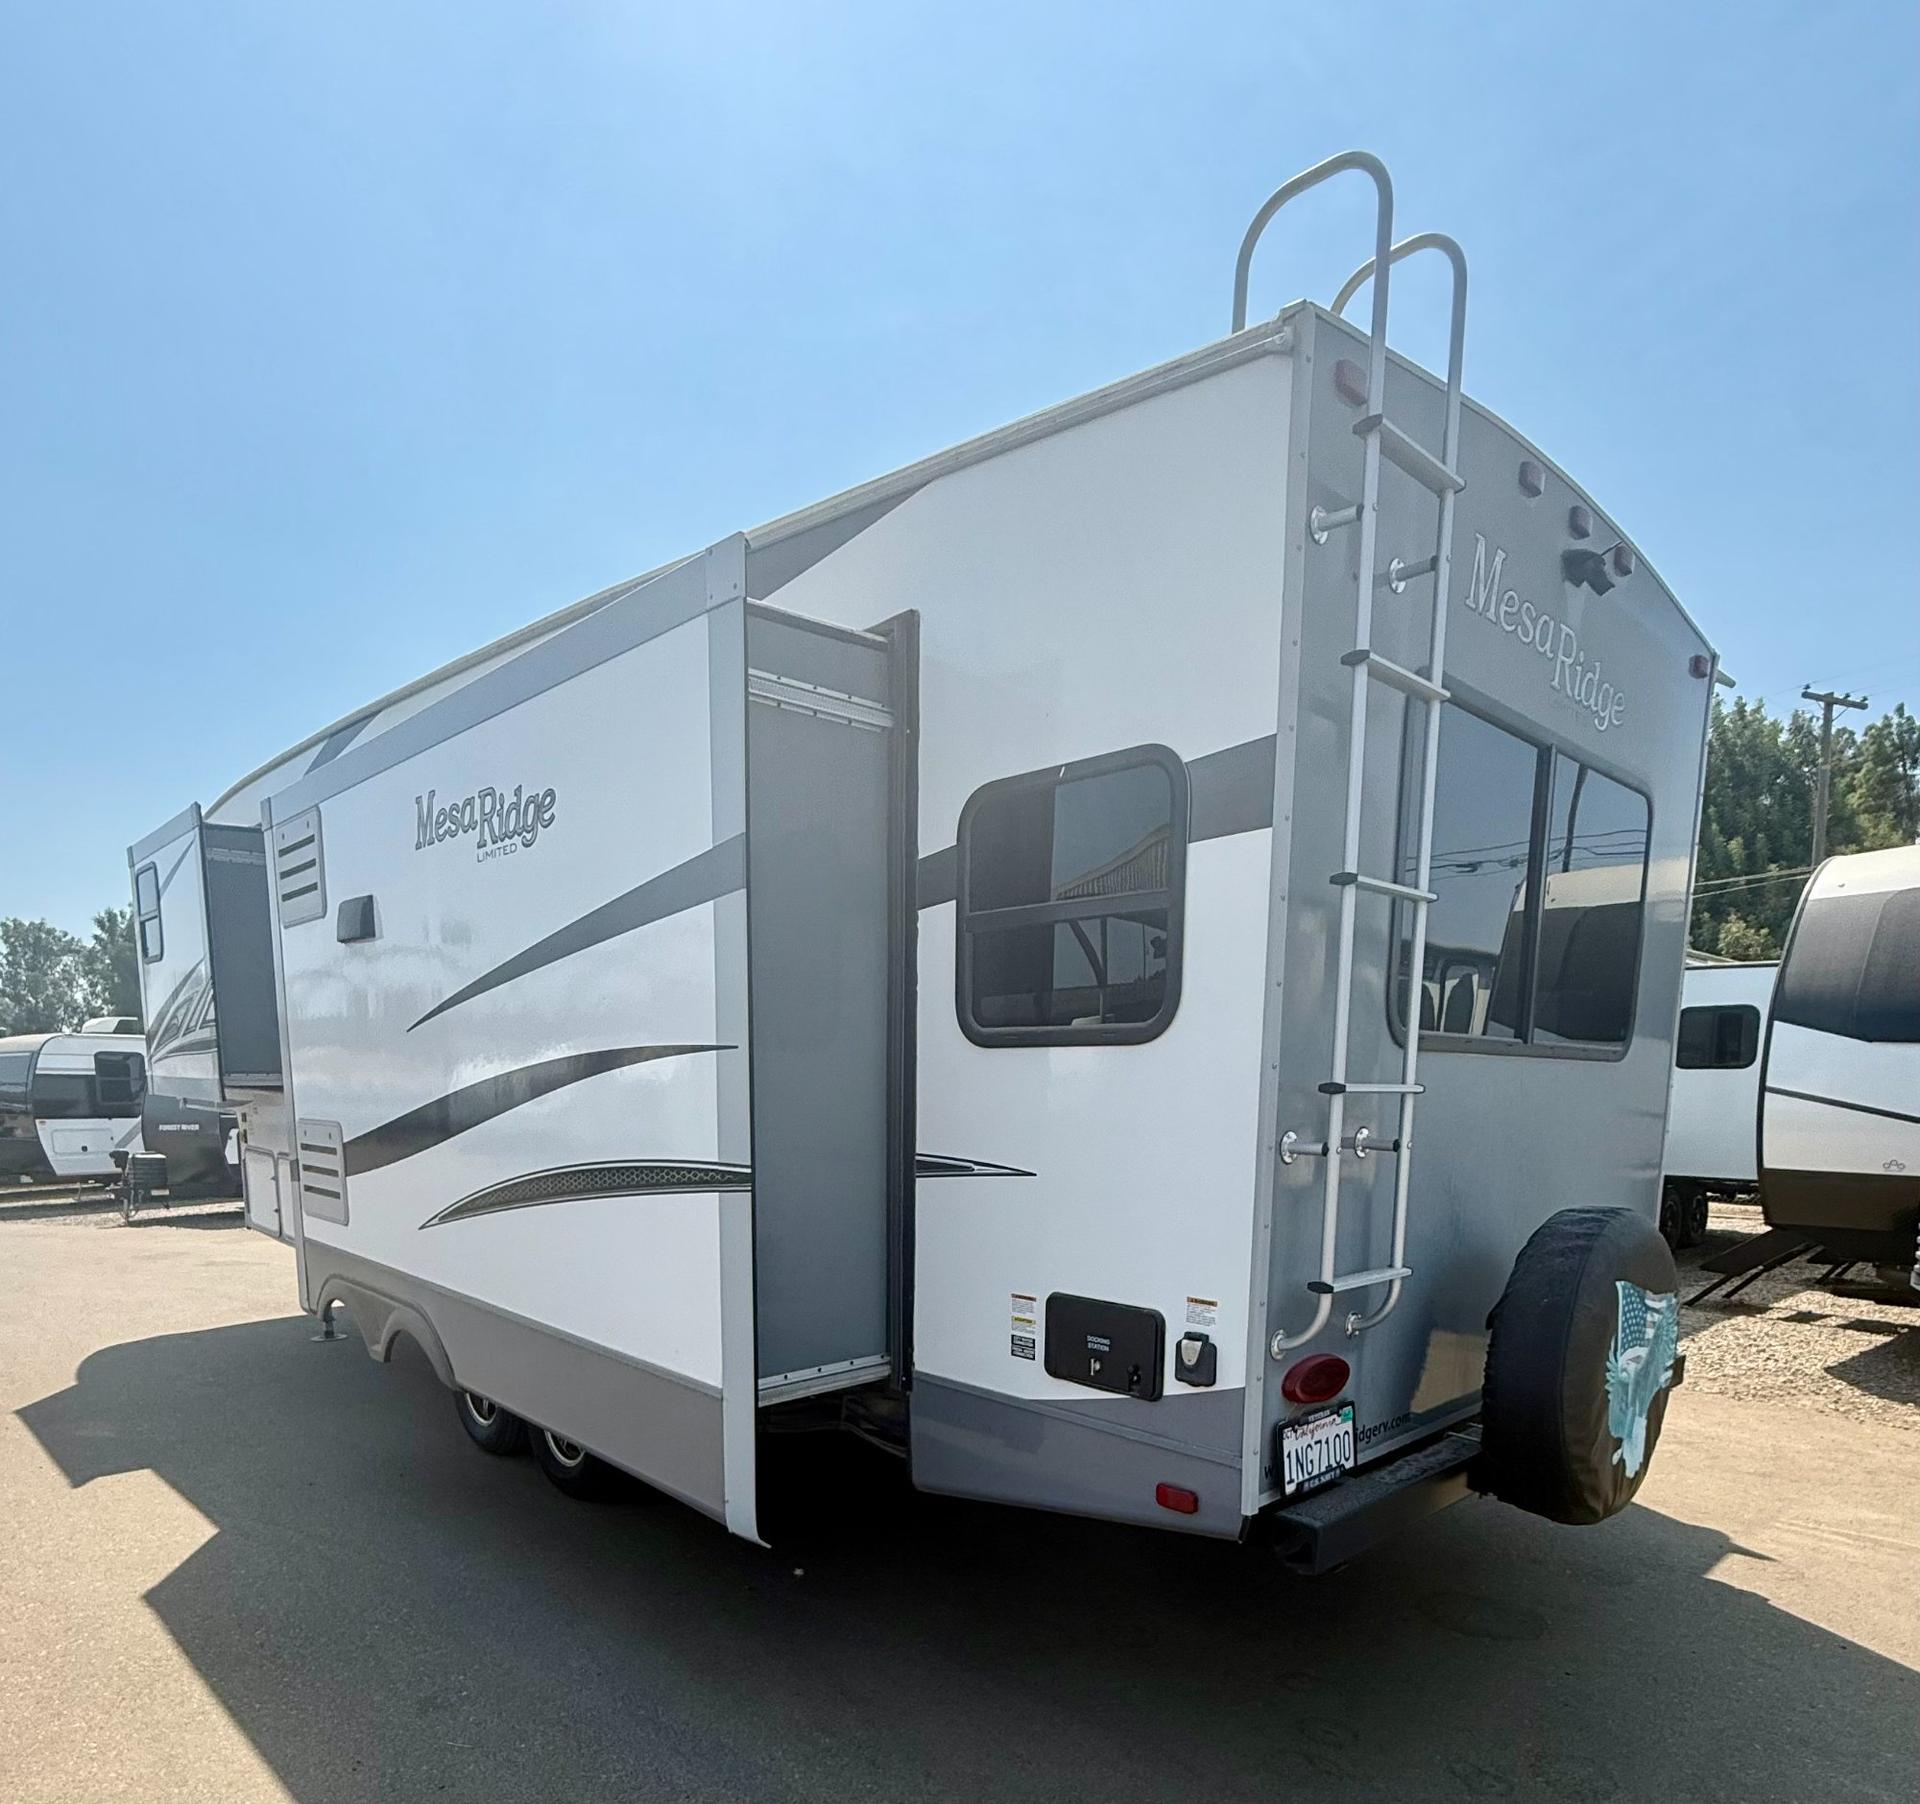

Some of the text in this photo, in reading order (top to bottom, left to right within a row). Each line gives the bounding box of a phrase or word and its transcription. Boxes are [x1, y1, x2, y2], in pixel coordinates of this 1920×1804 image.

[477, 843, 518, 863] LIMITED
[1087, 1335, 1110, 1345] DOCKING
[1087, 1342, 1110, 1351] STATION
[1286, 1430, 1350, 1486] 1NG7100
